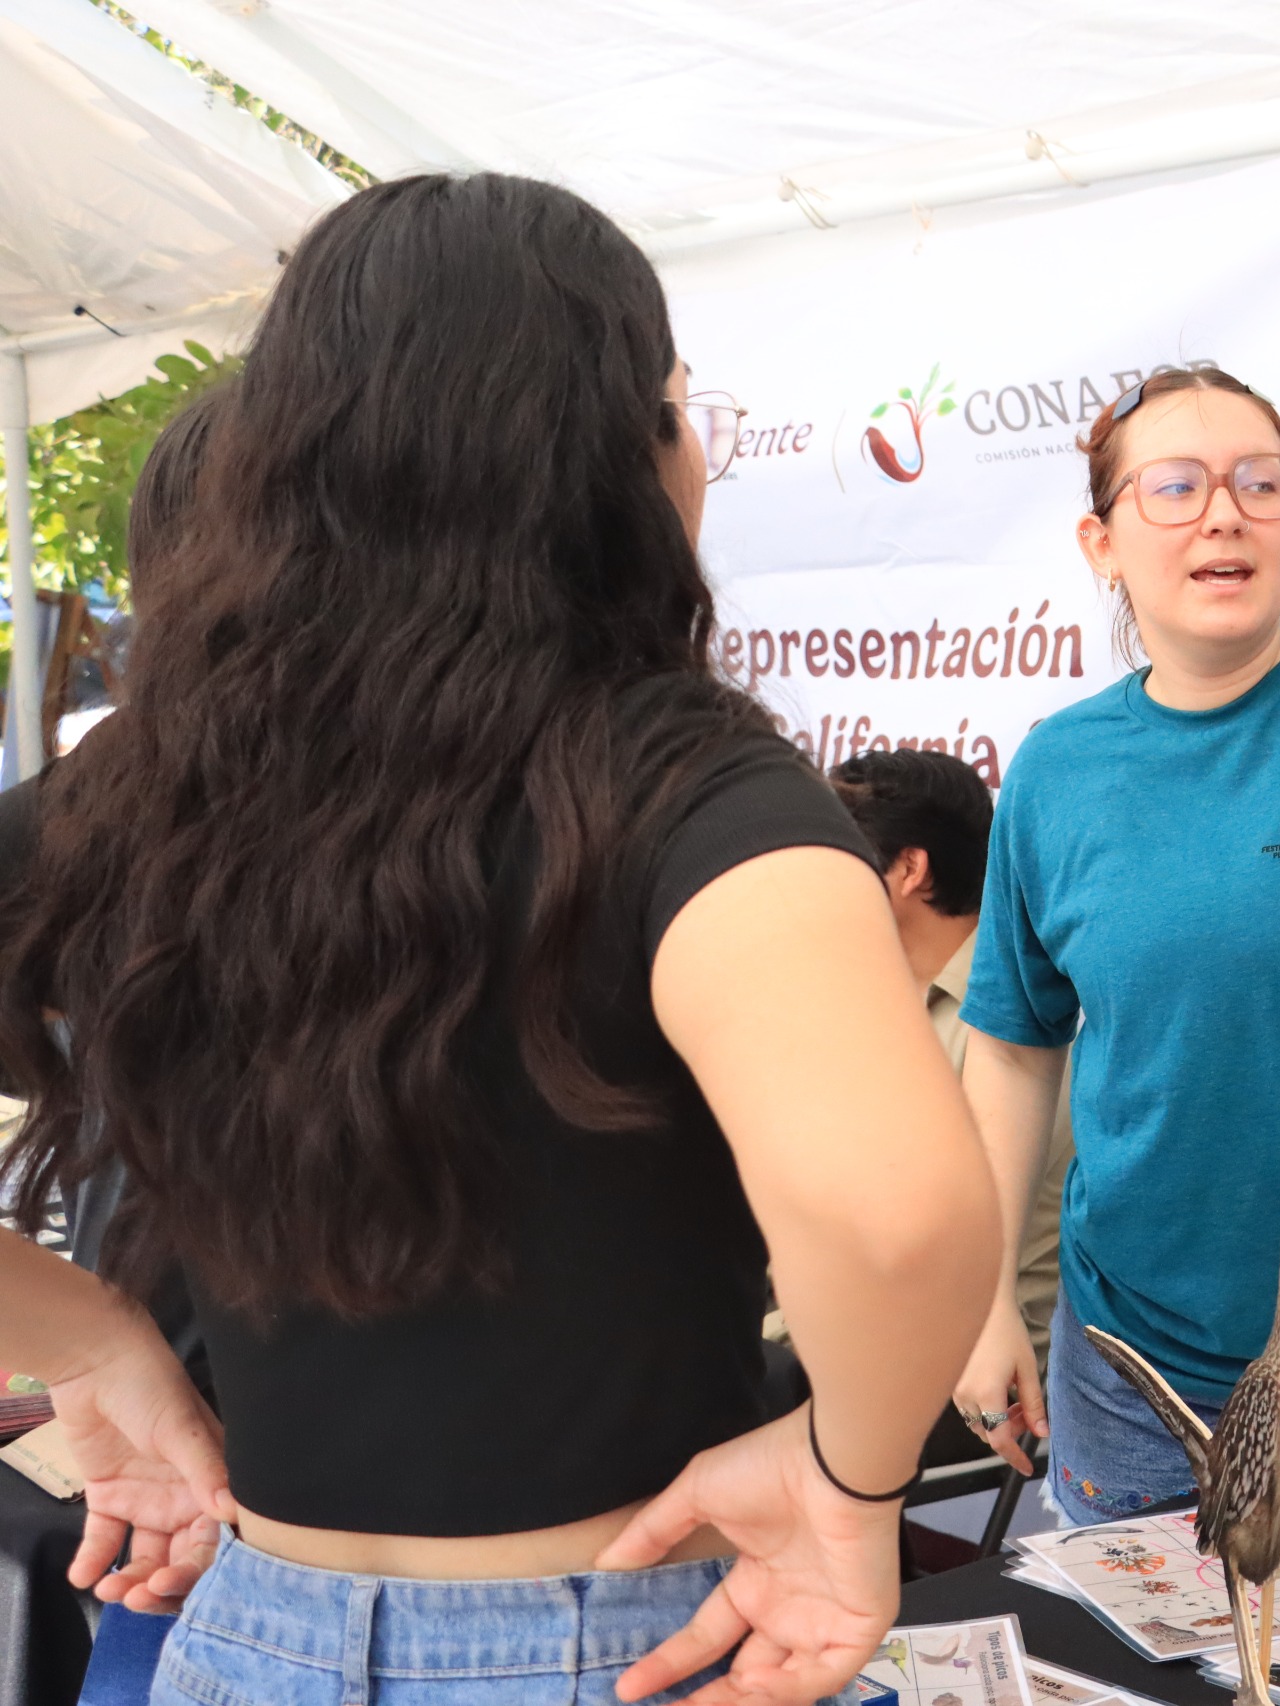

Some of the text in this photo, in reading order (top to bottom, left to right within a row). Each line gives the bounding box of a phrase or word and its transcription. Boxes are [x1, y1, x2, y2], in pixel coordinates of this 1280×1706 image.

[964, 359, 1220, 435] CONAF
[975, 446, 1041, 464] COMISIÓN
[708, 599, 1084, 692] epresentación
[987, 1631, 1008, 1680] Tipos de picos
